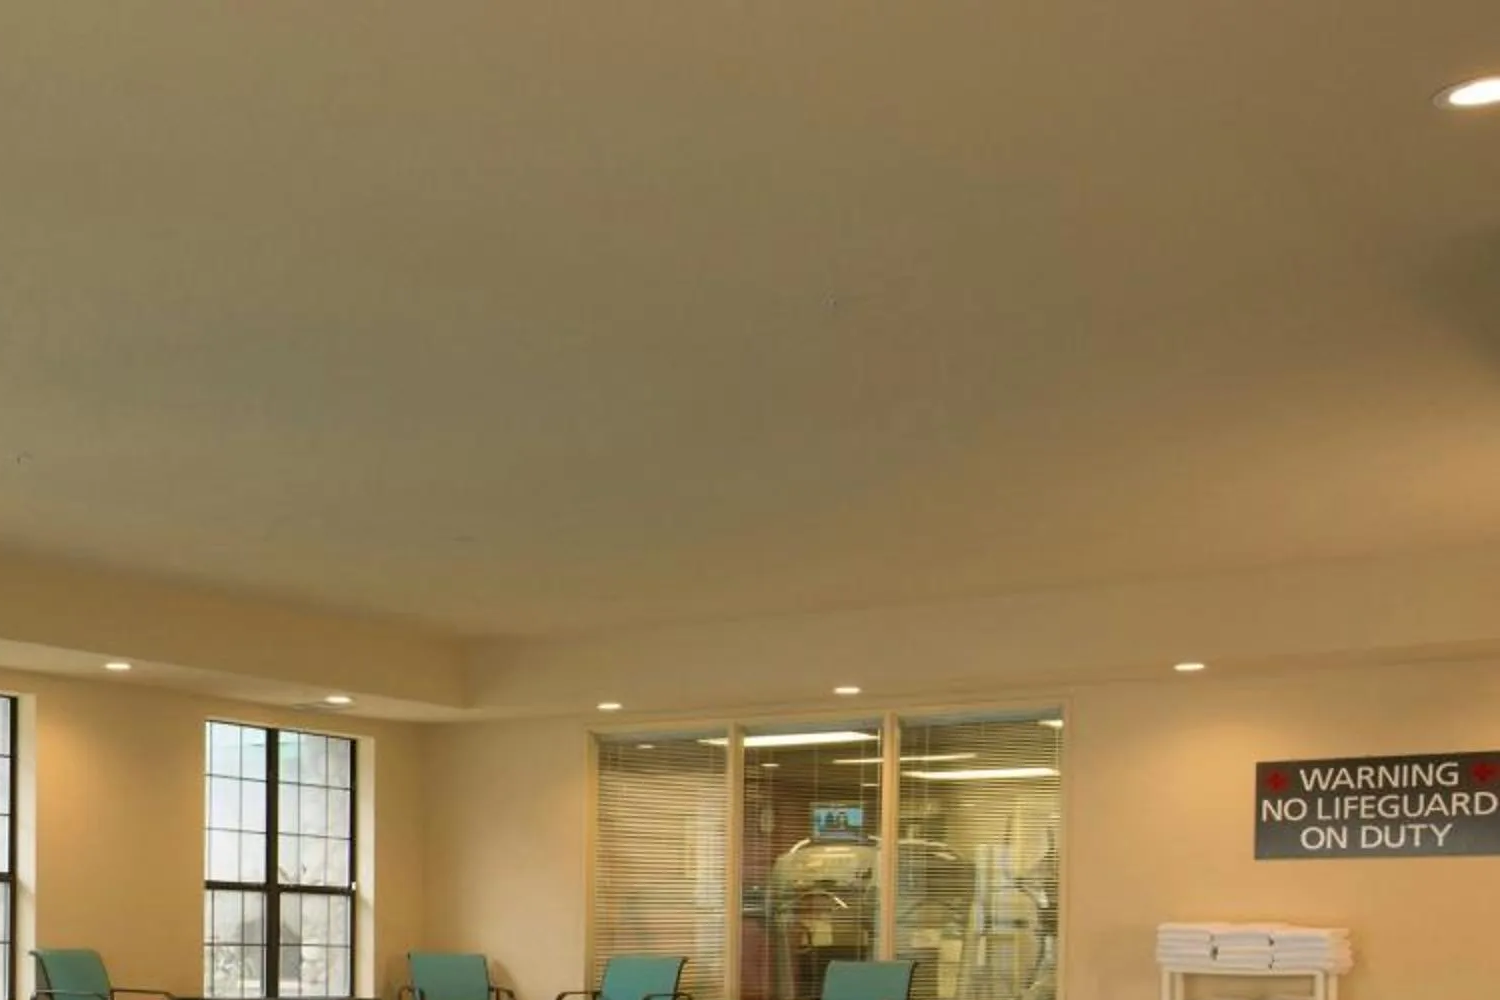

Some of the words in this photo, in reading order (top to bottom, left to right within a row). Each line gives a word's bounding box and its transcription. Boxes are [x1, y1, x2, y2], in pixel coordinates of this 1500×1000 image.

[1299, 761, 1460, 792] WARNING
[1261, 797, 1307, 822] NO
[1316, 791, 1499, 820] LIFEGUARD
[1299, 825, 1348, 850] ON
[1360, 823, 1454, 849] DUTY
